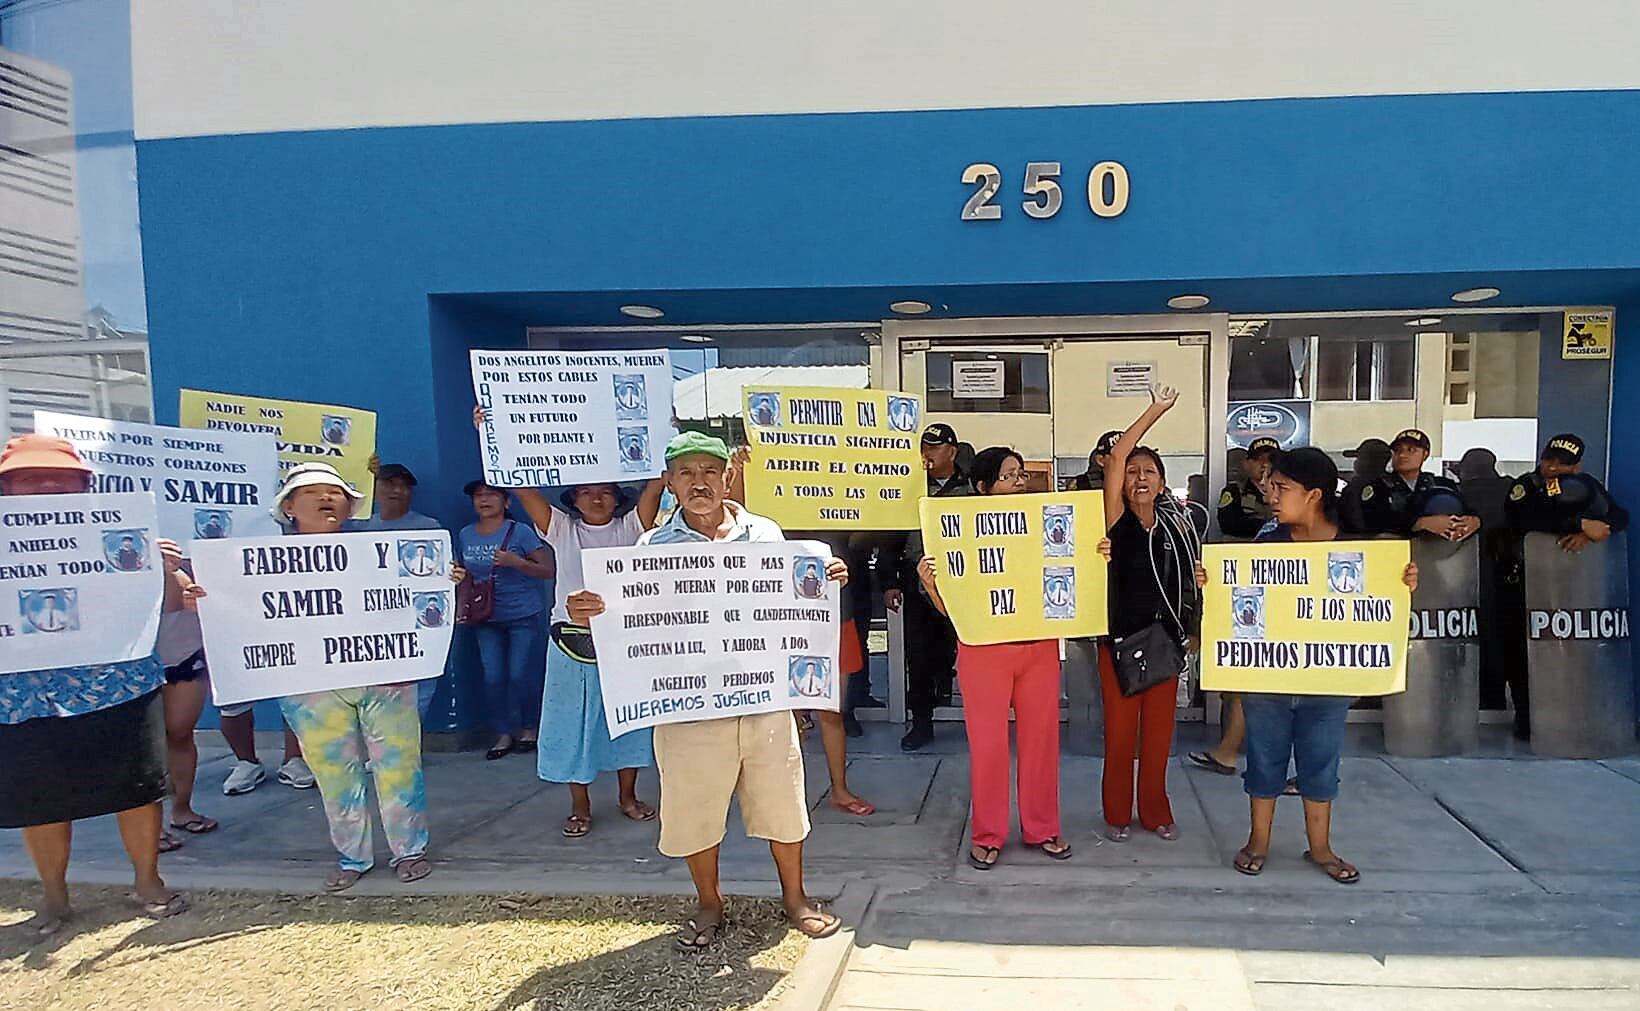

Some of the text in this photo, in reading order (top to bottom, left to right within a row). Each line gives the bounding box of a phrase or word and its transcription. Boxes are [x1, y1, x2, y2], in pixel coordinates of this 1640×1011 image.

[961, 161, 1129, 220] 250
[479, 356, 500, 366] DOS
[504, 356, 560, 366] ANGELITOS
[624, 356, 664, 366] MUEREN
[483, 372, 598, 382] POR ESTOS CABLES
[551, 394, 586, 403] TODO
[206, 402, 284, 418] NADIE NOS
[510, 412, 578, 423] UN FUTURO
[789, 399, 876, 427] PERMITIR UNA
[121, 433, 153, 446] POR
[162, 438, 224, 453] SIEMPRE
[518, 432, 594, 444] POR DELANTE Y
[760, 432, 911, 449] INJUSTICIA SIGNIFICA
[276, 442, 344, 456] VIDA
[79, 450, 246, 473] NUESTROS CORAZONES
[516, 455, 550, 467] AHORA
[554, 455, 566, 466] NO
[766, 459, 910, 476] ABRIR EL CAMINO
[488, 468, 561, 486] JUSTICIA
[164, 478, 260, 504] SAMIR
[775, 486, 901, 500] A TODAS LAS QUE
[3, 510, 122, 526] CUMPLIR SUS
[820, 508, 860, 520] SIGUEN
[941, 512, 1028, 538] SIN JUSTICIA
[9, 537, 78, 552] ANHELOS
[58, 560, 104, 575] TODO
[242, 543, 390, 576] FABRICIO Y
[606, 556, 784, 574] NO PERMITAMOS QUE MAS
[947, 548, 1005, 576] NO HAY
[1223, 559, 1309, 584] EN MEMORIA
[622, 580, 784, 598] NIÑOS MUERAN POR GENTE
[262, 588, 344, 620] SAMIR
[990, 590, 1016, 615] PAZ
[1297, 595, 1392, 622] DE LOS NIÑOS
[624, 608, 830, 628] IRRESPONSABLE QUE CLANDESTINAMENTE
[243, 632, 424, 670] SIEMPRE PRESENTE.
[628, 642, 672, 658] CONECTAN
[675, 642, 686, 654] LA
[722, 638, 730, 652] Y
[732, 638, 766, 652] AHORA
[780, 637, 788, 650] A
[790, 637, 808, 650] DOS
[1216, 640, 1392, 669] PEDIMOS JUSTICIA
[652, 671, 774, 692] ANGELITOS PERDEMOS
[713, 690, 771, 709] JUSTICIA
